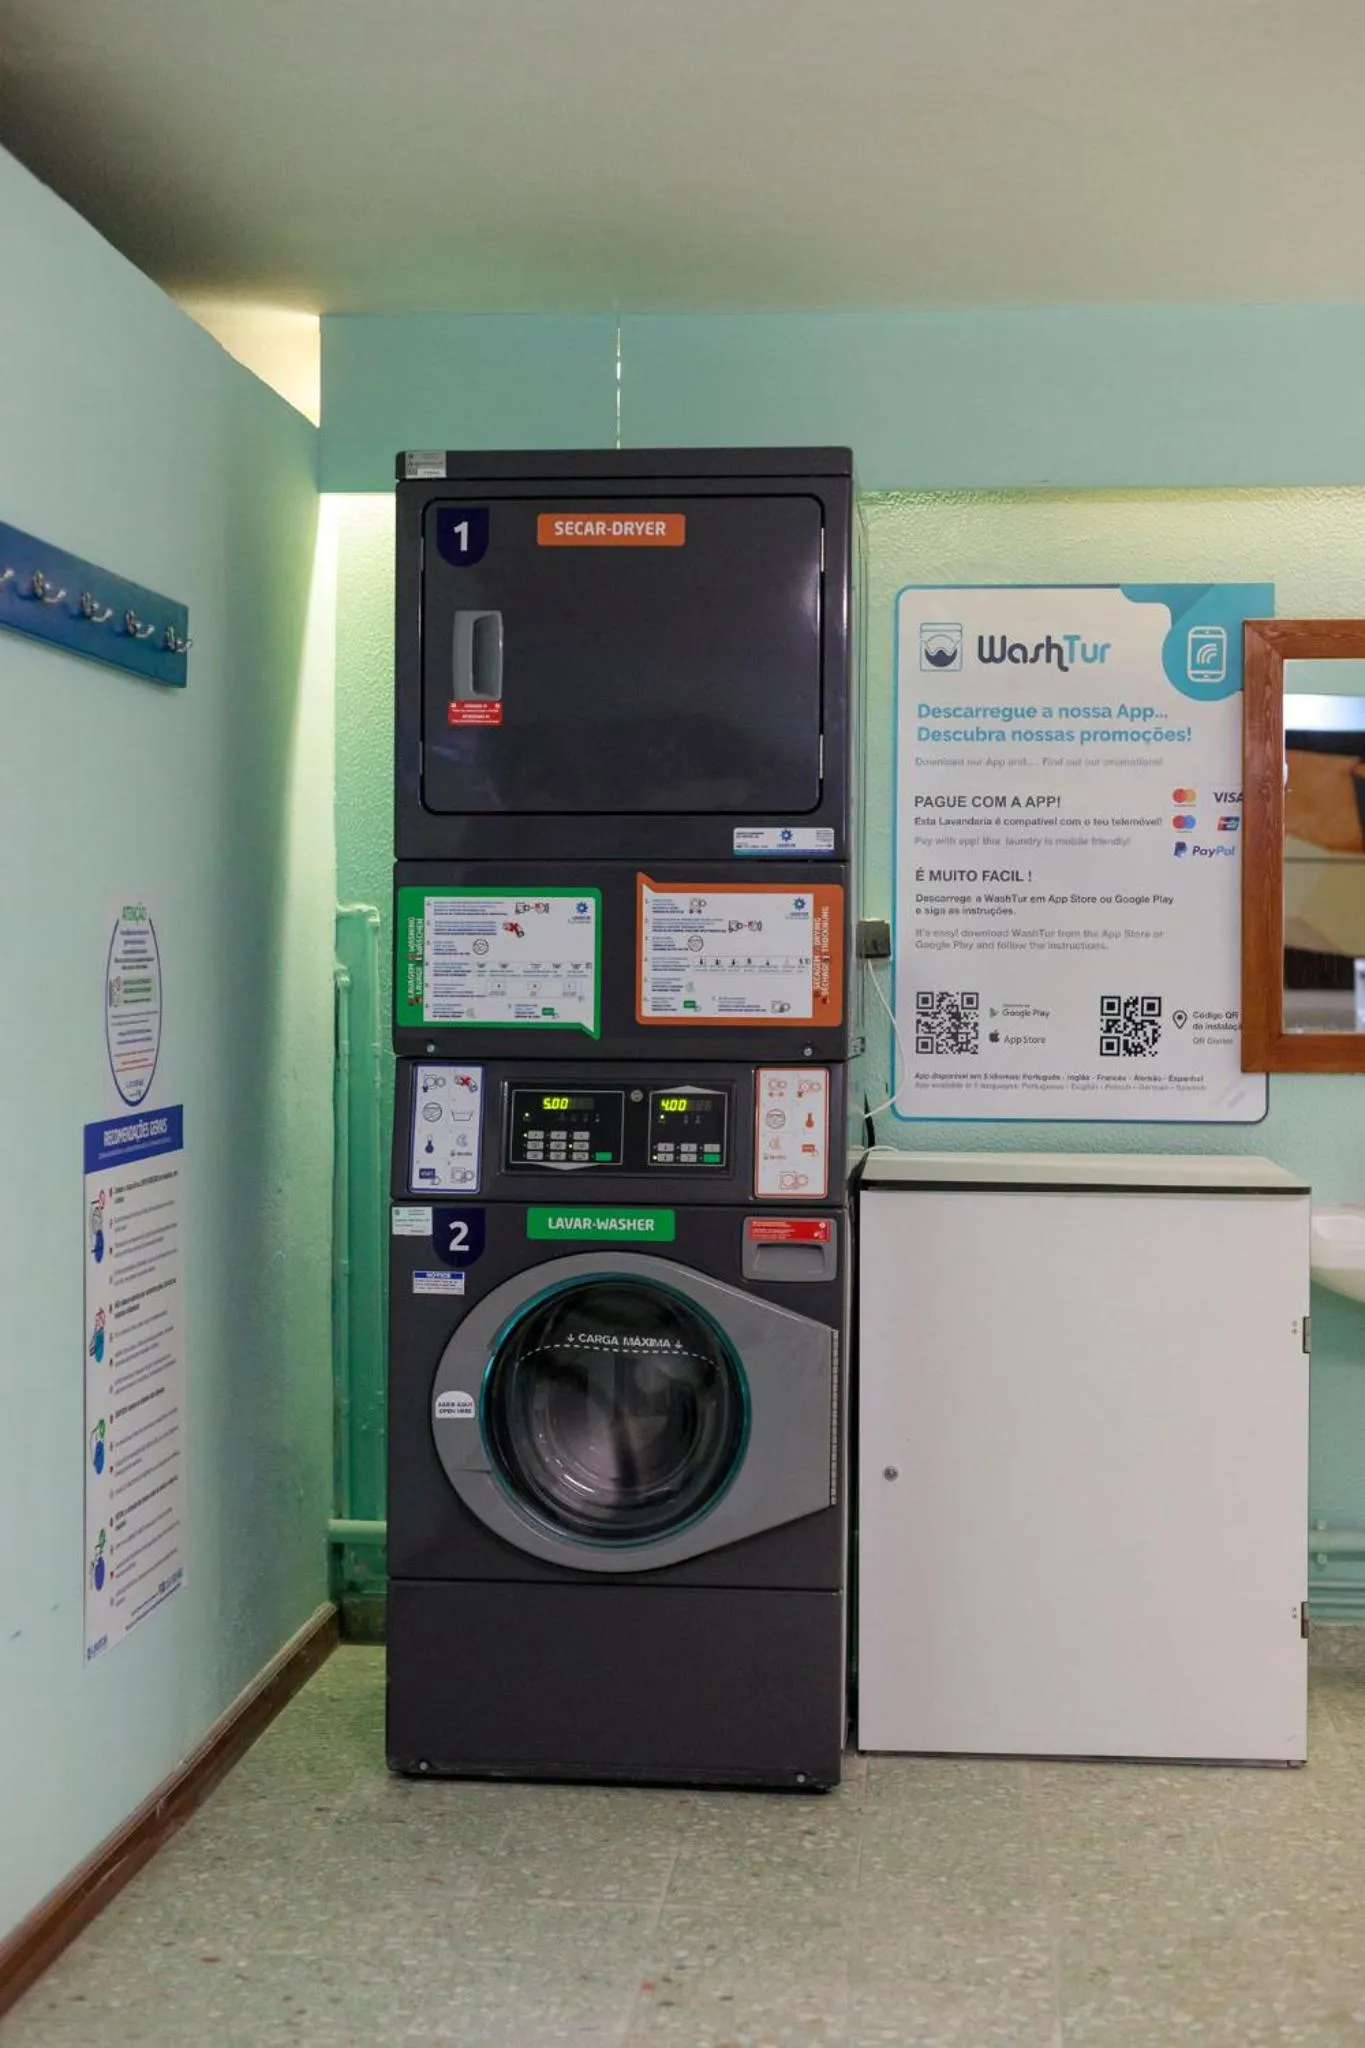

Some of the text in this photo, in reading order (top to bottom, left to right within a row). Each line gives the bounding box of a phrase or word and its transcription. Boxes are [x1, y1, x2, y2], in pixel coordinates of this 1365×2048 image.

[554, 520, 667, 537] SECAR-DRYER
[453, 521, 471, 551] 1
[978, 634, 1112, 672] WashTur
[918, 704, 1037, 722] Descarregue
[1043, 707, 1053, 718] a
[1059, 707, 1112, 719] nossa
[918, 726, 1191, 746] Descubra nossas promoções!
[986, 757, 1005, 769] App
[1042, 757, 1064, 766] Find
[914, 796, 1061, 808] PAGUE COM A APP!
[914, 817, 936, 826] Esta
[939, 817, 992, 826] Lavandaria
[995, 816, 1001, 826] é
[1060, 818, 1081, 826] com
[914, 837, 932, 847] Pay
[936, 837, 956, 846] with
[1005, 837, 1041, 847] laundry
[1055, 837, 1088, 846] mobile
[1192, 845, 1236, 857] PayPal
[915, 867, 924, 882] É
[928, 870, 978, 882] MUITO
[982, 870, 1024, 882] FACIL
[984, 894, 1027, 904] WashTur
[1030, 895, 1045, 904] em
[1048, 894, 1068, 906] App
[1070, 895, 1097, 904] Store
[1099, 896, 1112, 904] ou
[1115, 895, 1150, 906] Google
[1152, 895, 1174, 906] Play
[925, 907, 946, 917] siga
[961, 928, 1009, 938] download
[1011, 928, 1055, 938] WashTur
[1058, 929, 1080, 938] from
[1101, 929, 1122, 940] App
[953, 941, 973, 951] Play
[1001, 1008, 1051, 1019] Google Play
[1004, 1035, 1047, 1045] App Store
[542, 1097, 569, 1110] 5.00
[660, 1099, 688, 1112] 4.00
[547, 1217, 655, 1232] LAVAR-WASHER
[448, 1220, 470, 1252] 2
[578, 1333, 671, 1349] CARGA MÁXIMA
